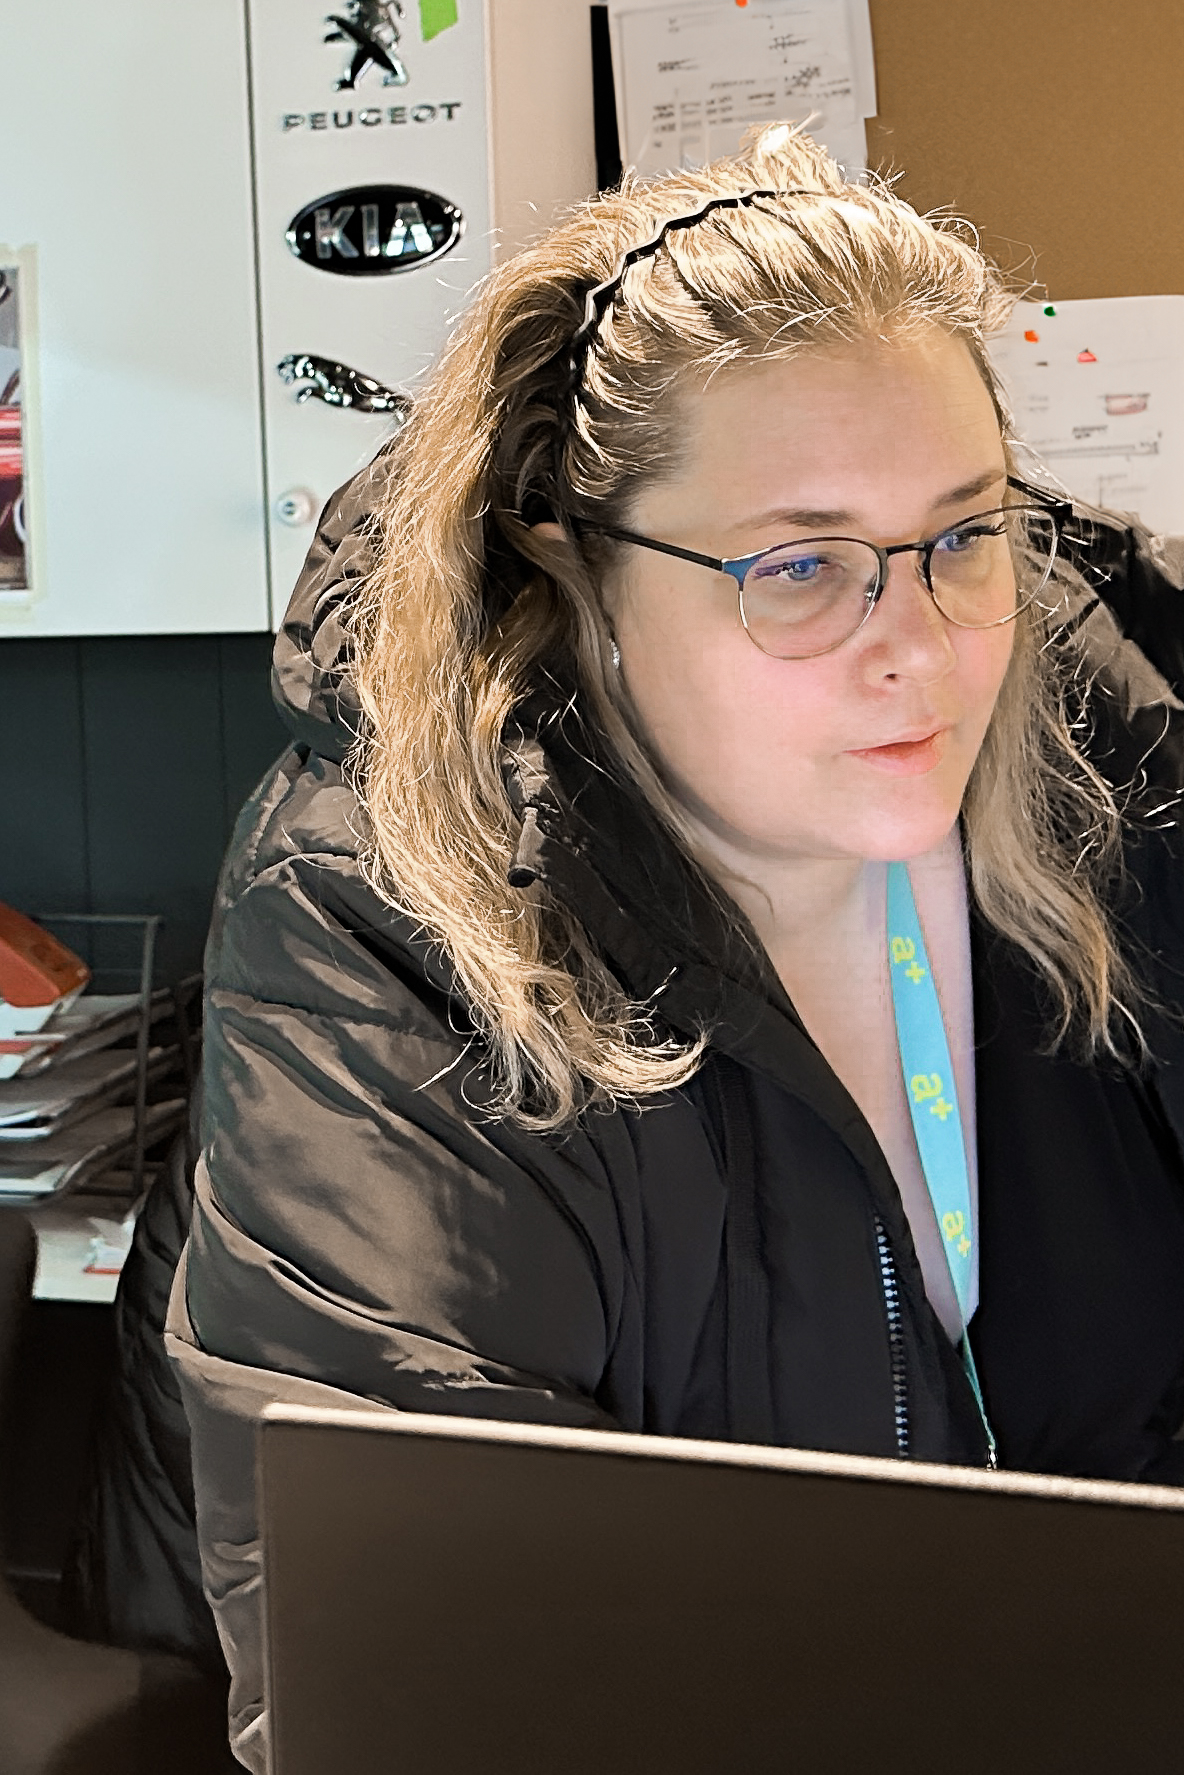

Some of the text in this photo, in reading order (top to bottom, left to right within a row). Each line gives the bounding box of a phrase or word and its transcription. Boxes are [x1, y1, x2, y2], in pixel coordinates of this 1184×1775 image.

[282, 102, 462, 131] PEUGEOT
[314, 201, 434, 258] KIA
[892, 936, 925, 984] a+
[911, 1073, 953, 1121] a+
[942, 1210, 971, 1257] a+
